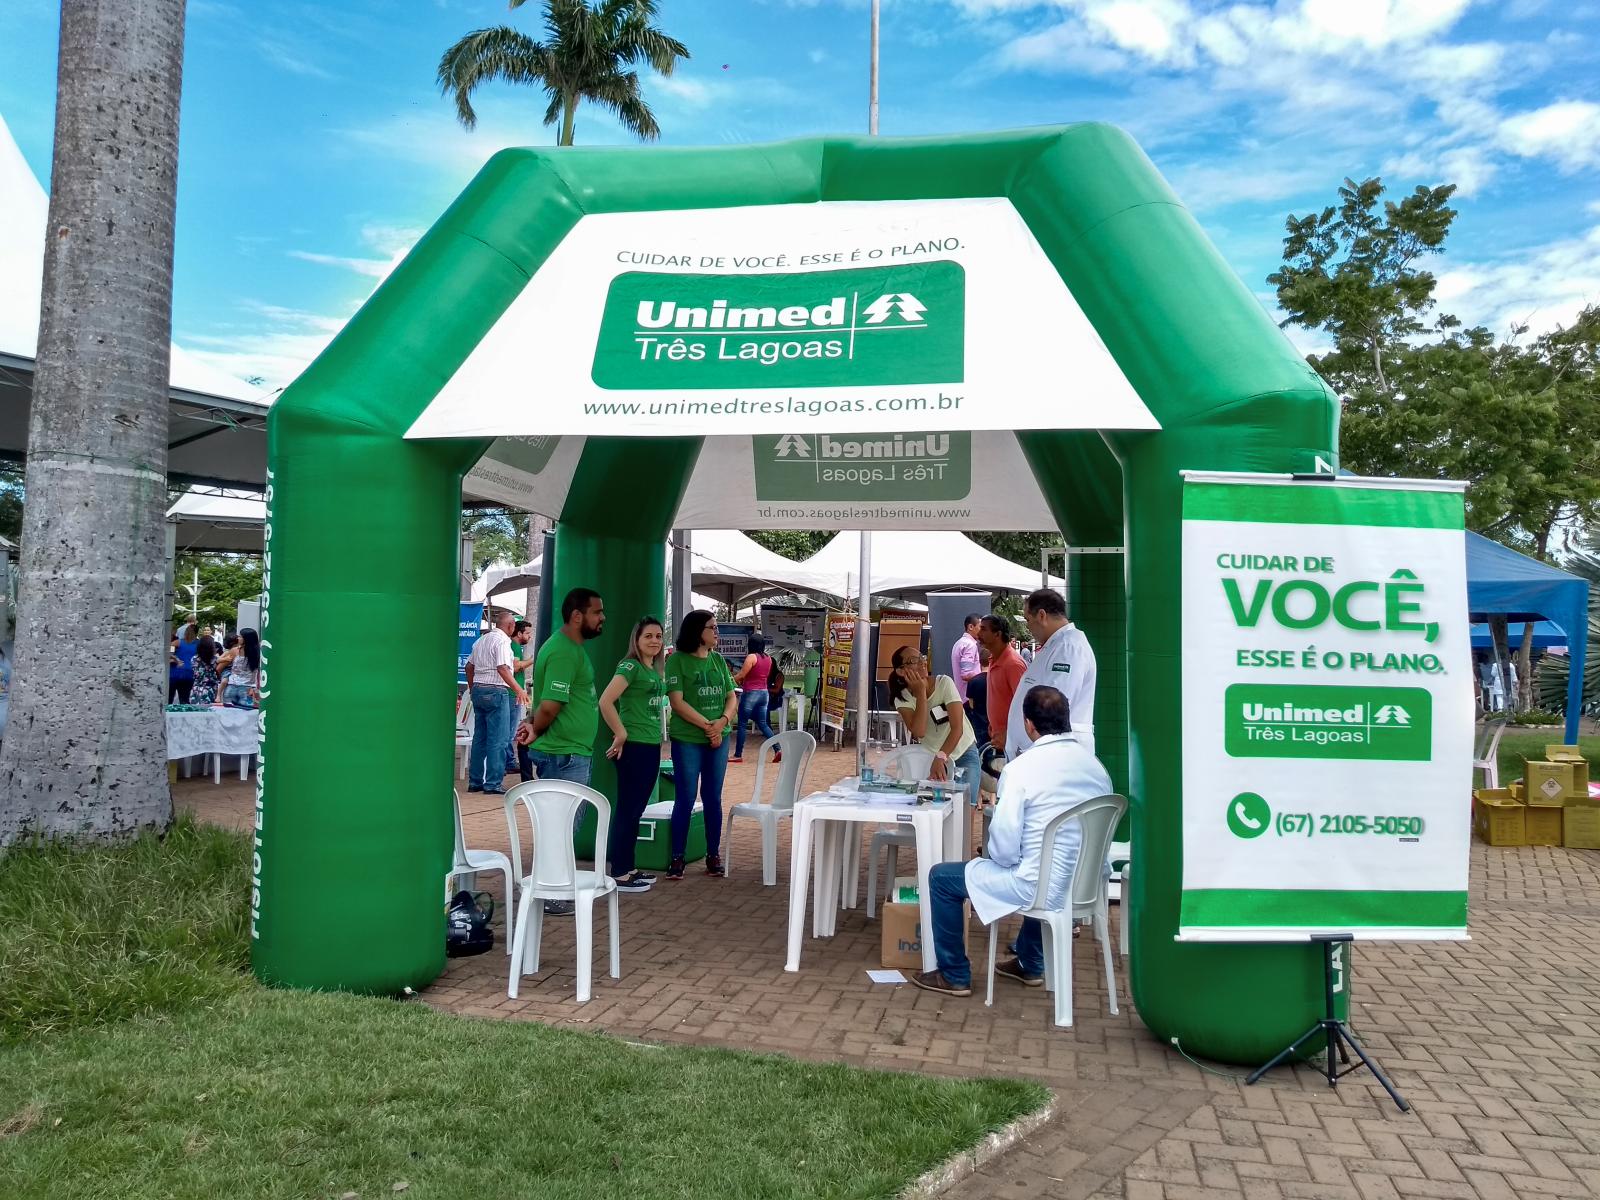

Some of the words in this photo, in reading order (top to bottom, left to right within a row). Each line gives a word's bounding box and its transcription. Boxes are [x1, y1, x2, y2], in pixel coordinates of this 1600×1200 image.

[616, 250, 692, 268] CUIDAR
[699, 254, 726, 269] DE
[799, 251, 844, 267] ESSE
[850, 248, 862, 263] É
[868, 248, 883, 260] O
[890, 237, 966, 258] PLANO.
[636, 297, 847, 329] Unimed
[634, 337, 706, 361] Três
[718, 337, 844, 365] Lagoas
[583, 392, 965, 417] www.unimedtreslagoas.com.br
[1216, 553, 1297, 572] CUIDAR
[1303, 556, 1335, 573] DE
[1221, 568, 1441, 643] VOCÊ,
[1236, 649, 1295, 667] ESSE
[1301, 644, 1317, 668] É
[1322, 651, 1344, 669] O
[1350, 653, 1446, 674] PLANO.
[1242, 702, 1364, 724] Unimed
[1243, 726, 1285, 742] Três
[1292, 727, 1364, 745] Lagoas
[251, 709, 267, 940] FISIOTERAPIA
[1275, 812, 1314, 838] (67)
[1320, 814, 1422, 835] 2105-5050
